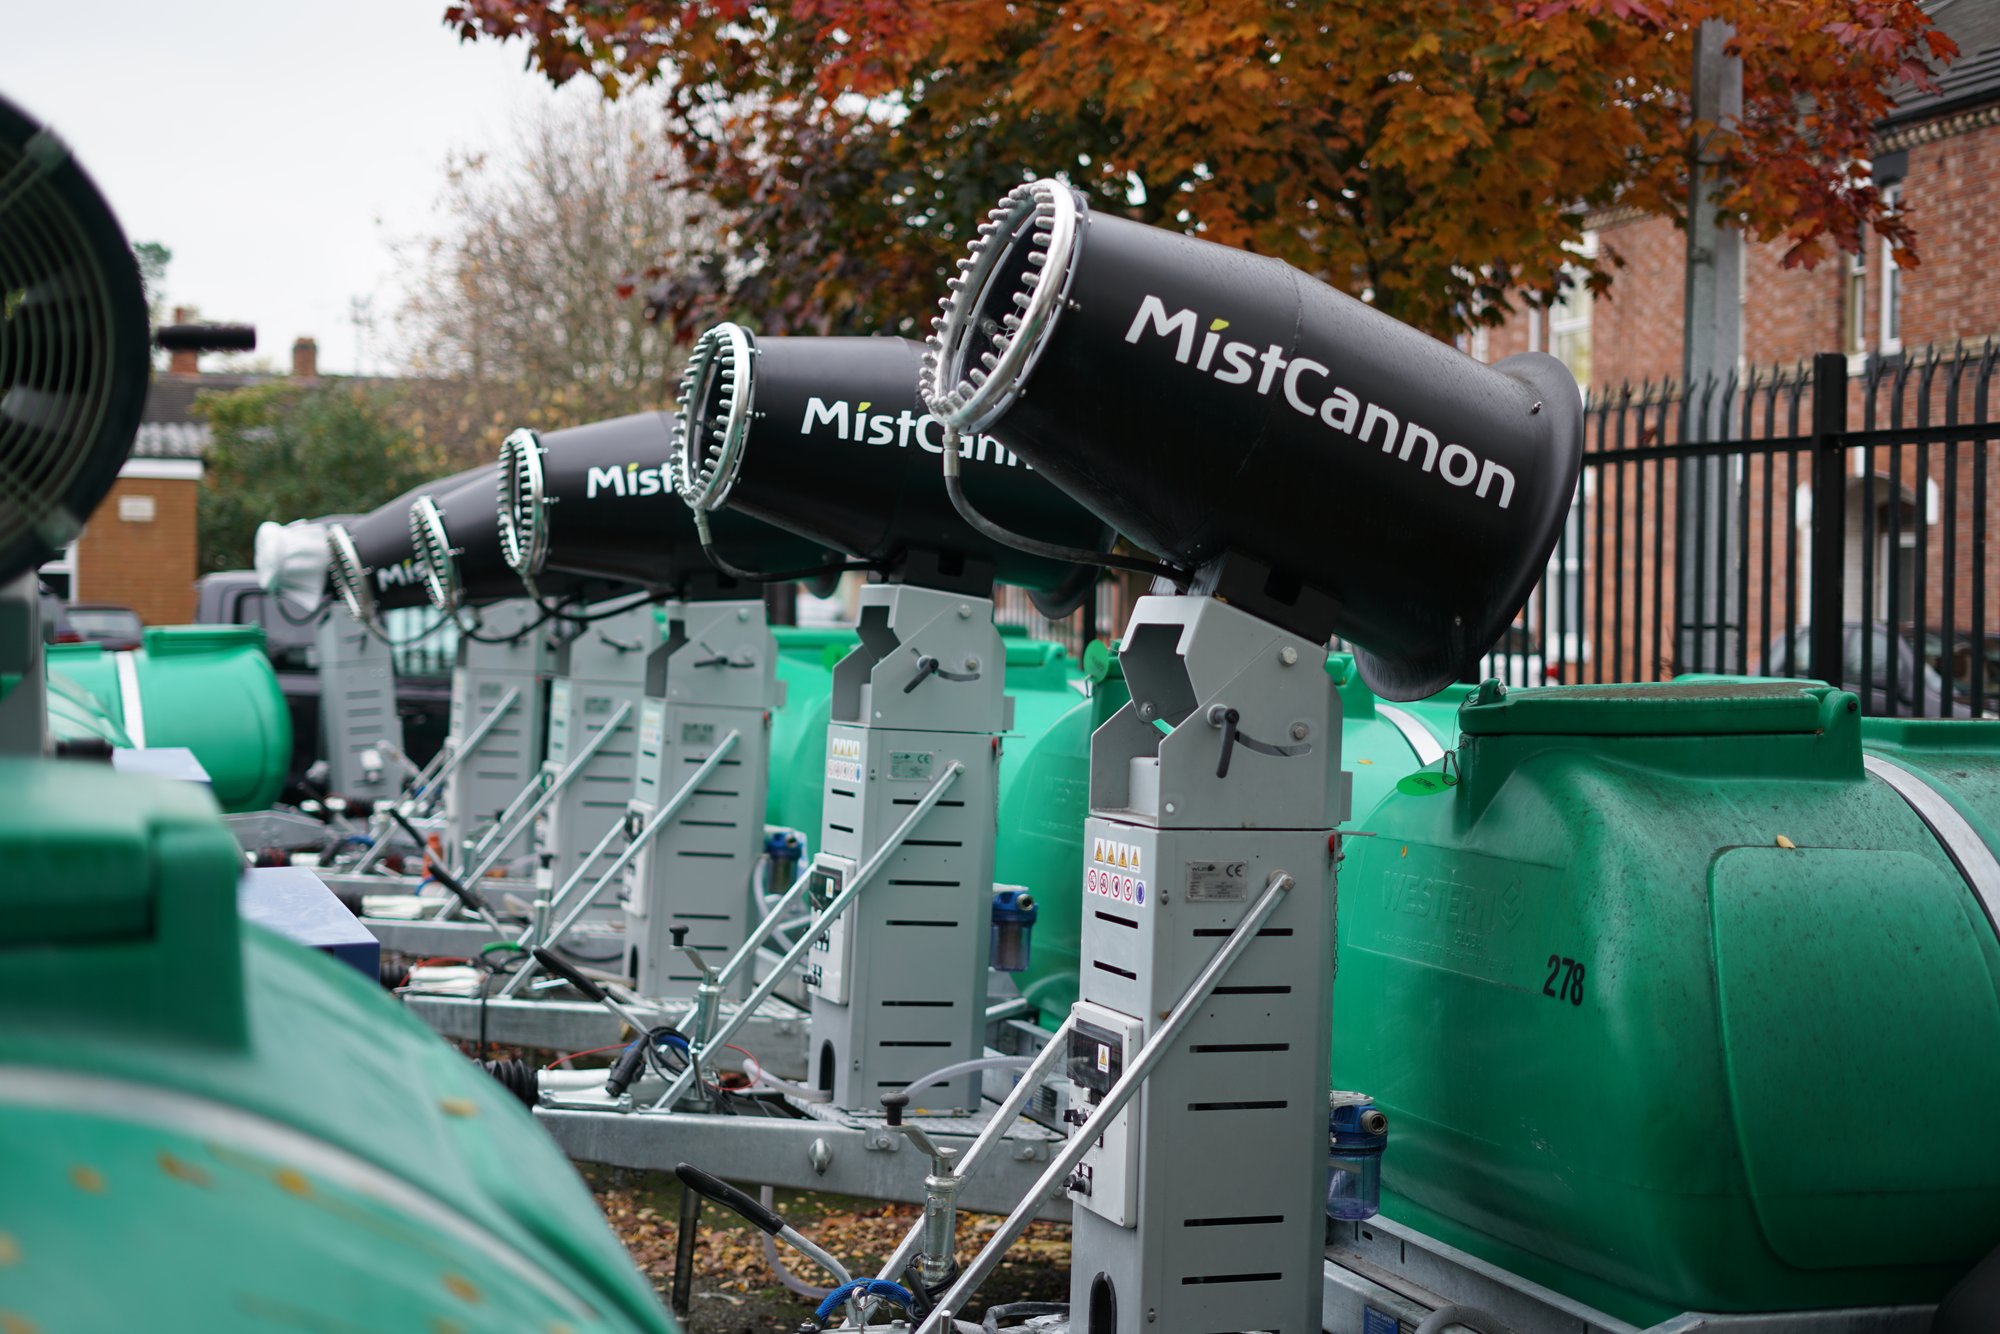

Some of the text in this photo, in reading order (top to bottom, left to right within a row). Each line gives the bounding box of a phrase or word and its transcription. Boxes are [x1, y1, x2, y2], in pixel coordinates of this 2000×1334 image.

[1124, 294, 1516, 509] MistCannon
[586, 461, 677, 499] Mist
[1226, 863, 1243, 878] CE
[1542, 953, 1585, 1007] 278
